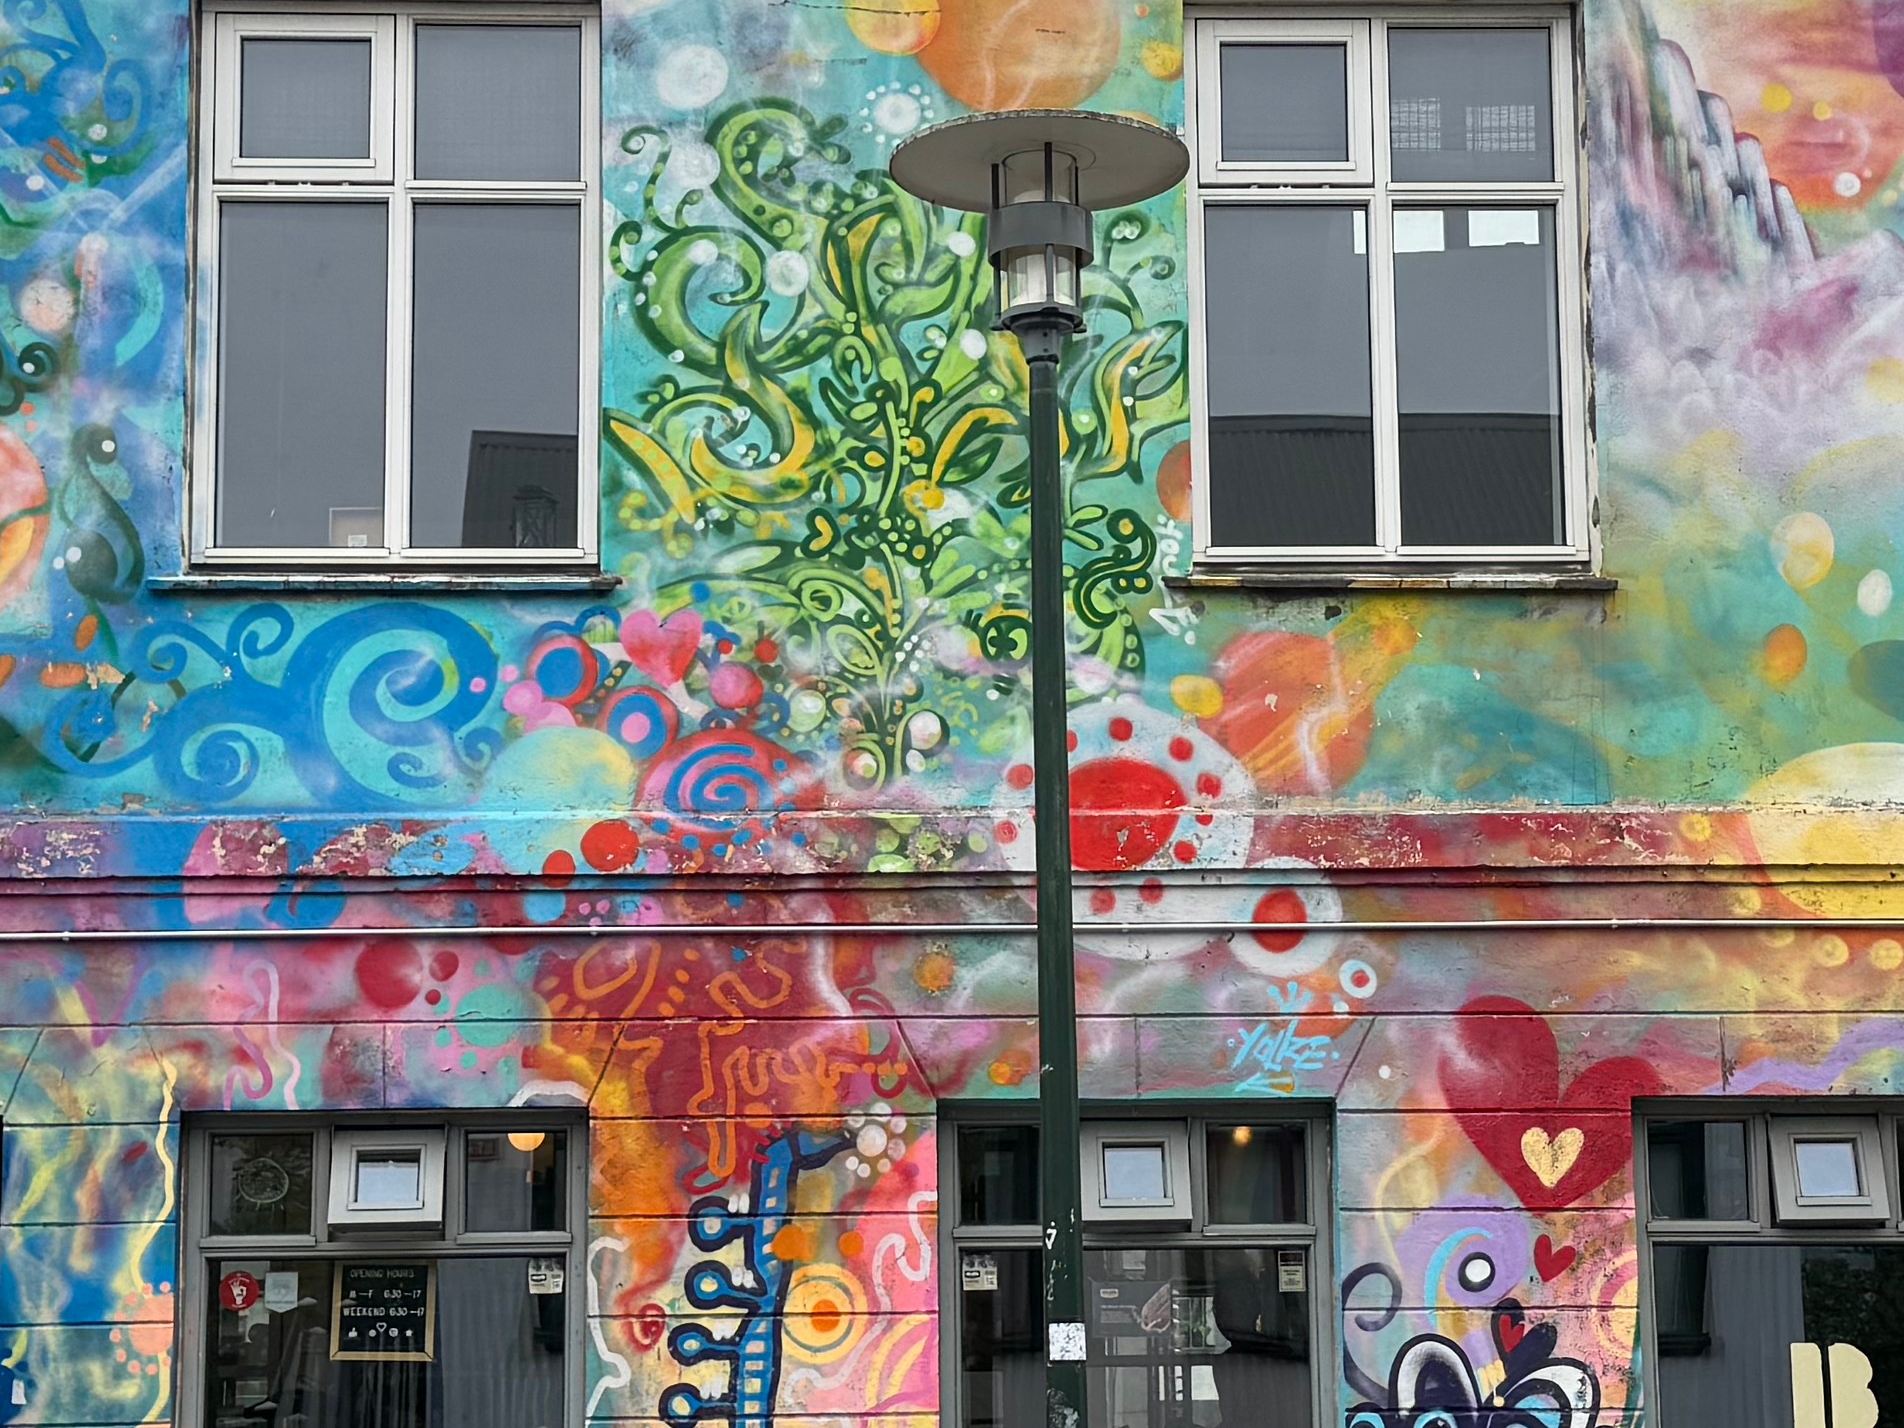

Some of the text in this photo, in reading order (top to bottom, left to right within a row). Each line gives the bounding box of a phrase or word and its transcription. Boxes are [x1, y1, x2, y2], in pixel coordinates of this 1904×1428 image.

[350, 1268, 414, 1278] OPENING HOURS
[343, 1307, 385, 1316] WEEKEND
